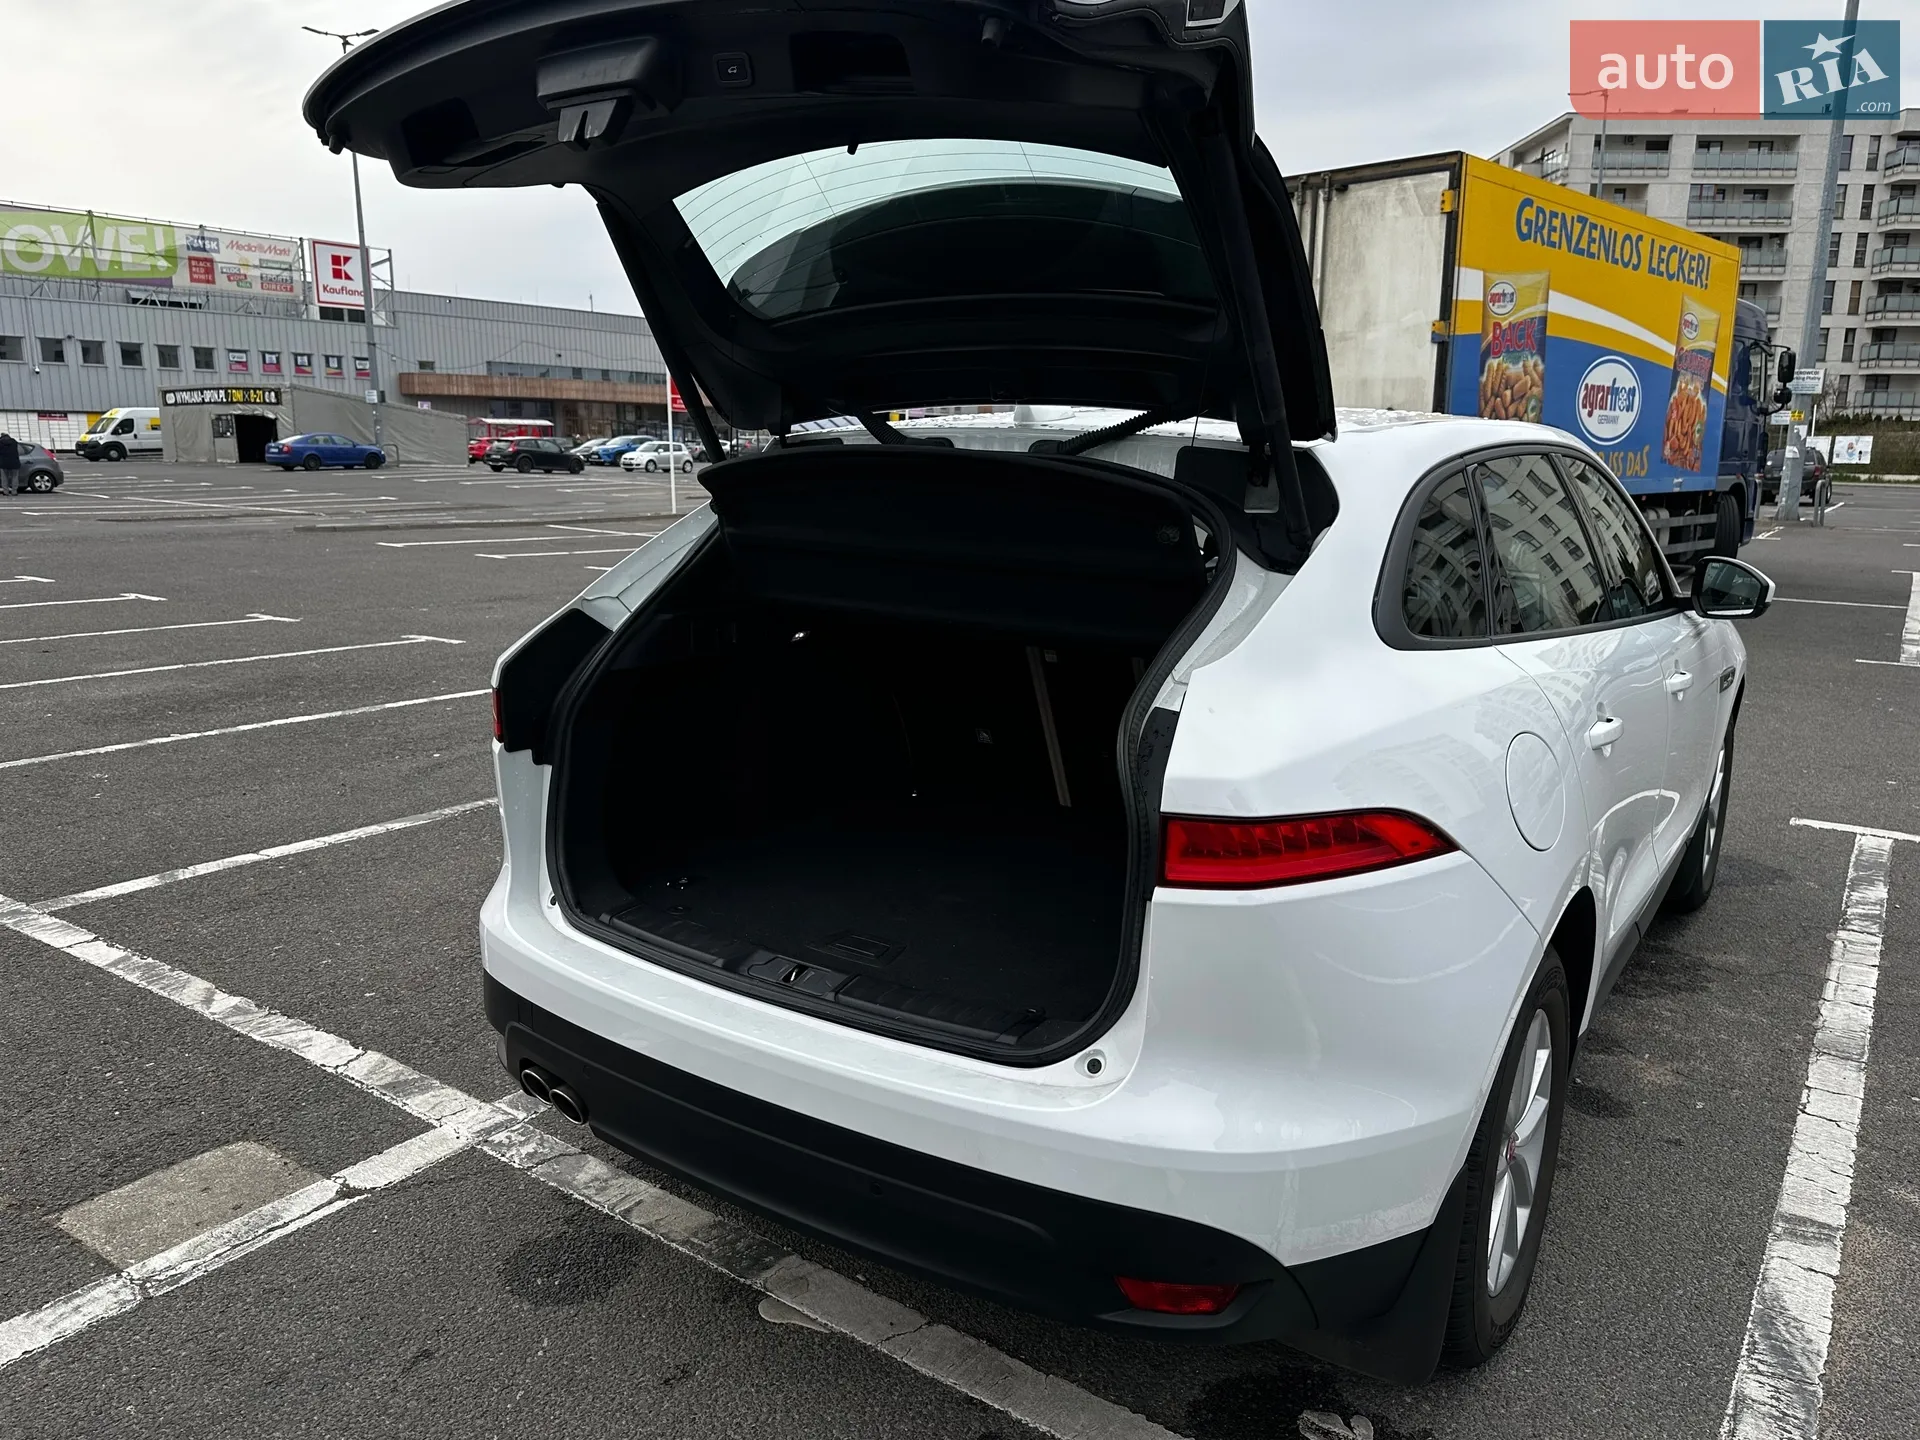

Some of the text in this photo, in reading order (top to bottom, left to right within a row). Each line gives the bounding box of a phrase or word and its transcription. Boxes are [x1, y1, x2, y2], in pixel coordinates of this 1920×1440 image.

[0, 224, 168, 273] OWE!
[193, 239, 218, 250] JYSK
[1515, 197, 1711, 290] GRENZENLOS LECKER!
[262, 274, 292, 283] SPORTS
[263, 283, 291, 291] DIRECT
[1490, 320, 1537, 359] BACK
[1581, 377, 1636, 418] agrarfrost
[1597, 414, 1620, 425] GERMANY
[1608, 445, 1650, 477] ISS DAS
